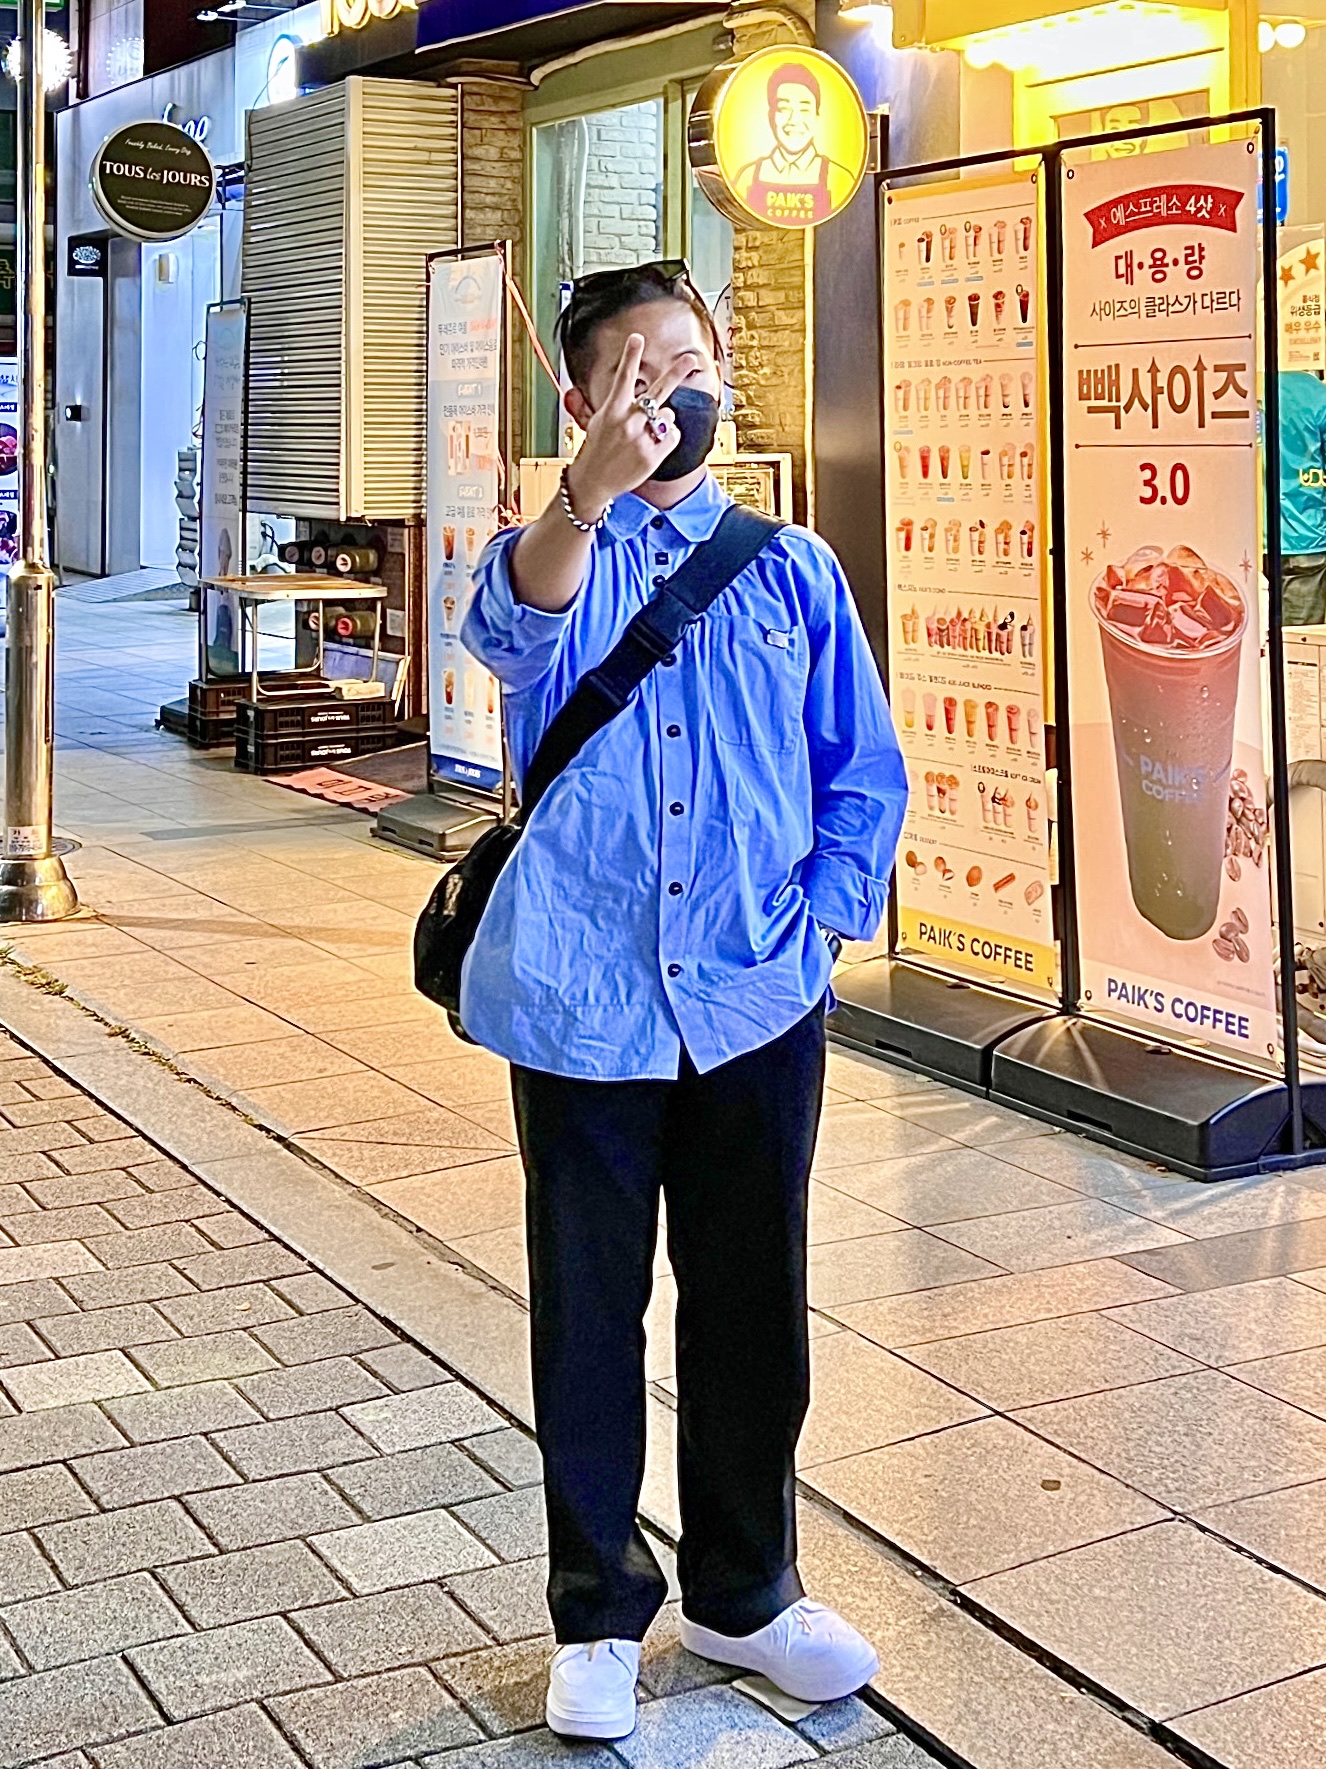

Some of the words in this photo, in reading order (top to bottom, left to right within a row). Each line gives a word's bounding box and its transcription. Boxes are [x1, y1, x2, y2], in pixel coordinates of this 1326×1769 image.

[103, 161, 144, 178] TOUS
[147, 168, 161, 180] les
[162, 170, 210, 187] JOURS
[766, 191, 814, 208] PAIK'S
[767, 209, 814, 218] COFFEE
[1110, 194, 1182, 226] 에스프레소
[1185, 194, 1214, 219] 4샷
[1090, 297, 1141, 322] 사이즈의
[1144, 292, 1198, 318] 클라스가
[1201, 289, 1241, 314] 다르다
[1078, 354, 1250, 430] 빽사이즈
[1139, 462, 1190, 505] 3.0
[919, 922, 965, 952] PAIK'S
[970, 938, 1034, 972] COFFEE
[1107, 977, 1165, 1014] PAIK'S
[1171, 998, 1250, 1039] COFFEE
